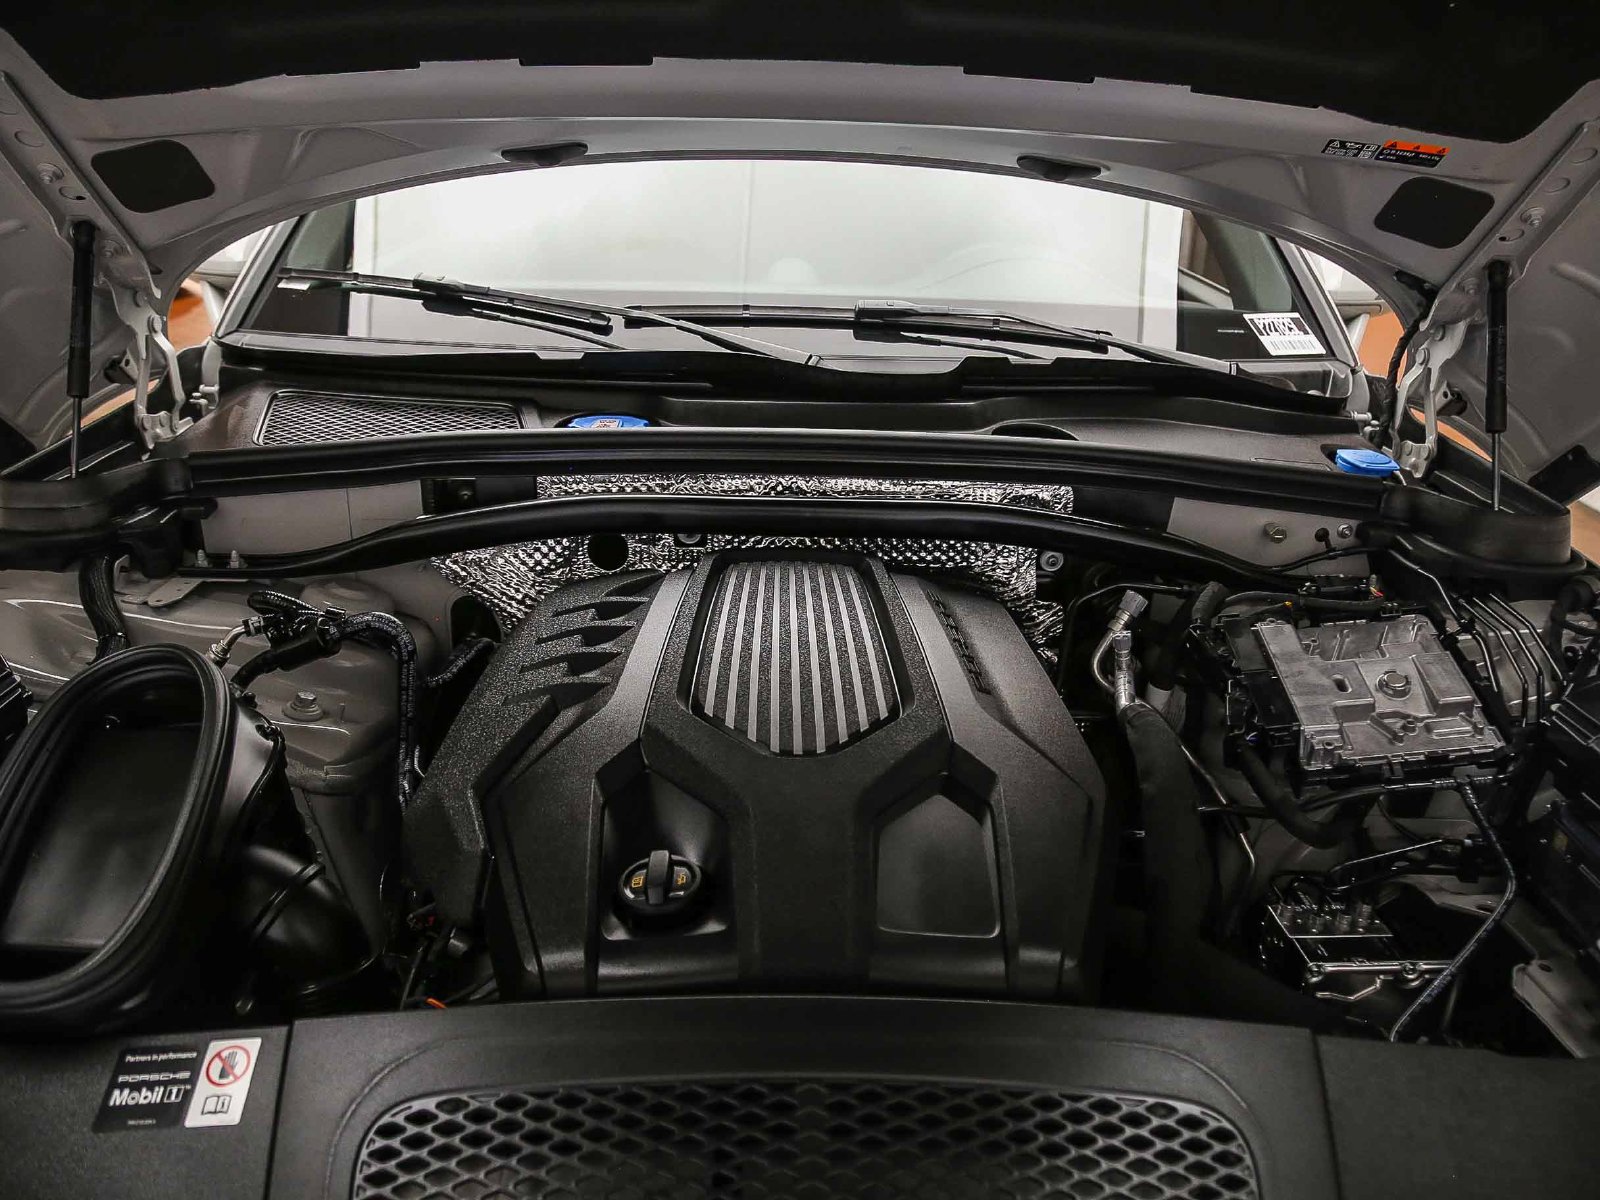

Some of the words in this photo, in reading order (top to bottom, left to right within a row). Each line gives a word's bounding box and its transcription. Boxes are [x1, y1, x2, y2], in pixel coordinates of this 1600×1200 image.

[125, 1054, 151, 1063] Partners
[158, 1051, 198, 1062] performance
[118, 1070, 191, 1083] PORSCHE
[108, 1086, 164, 1107] Mobil
